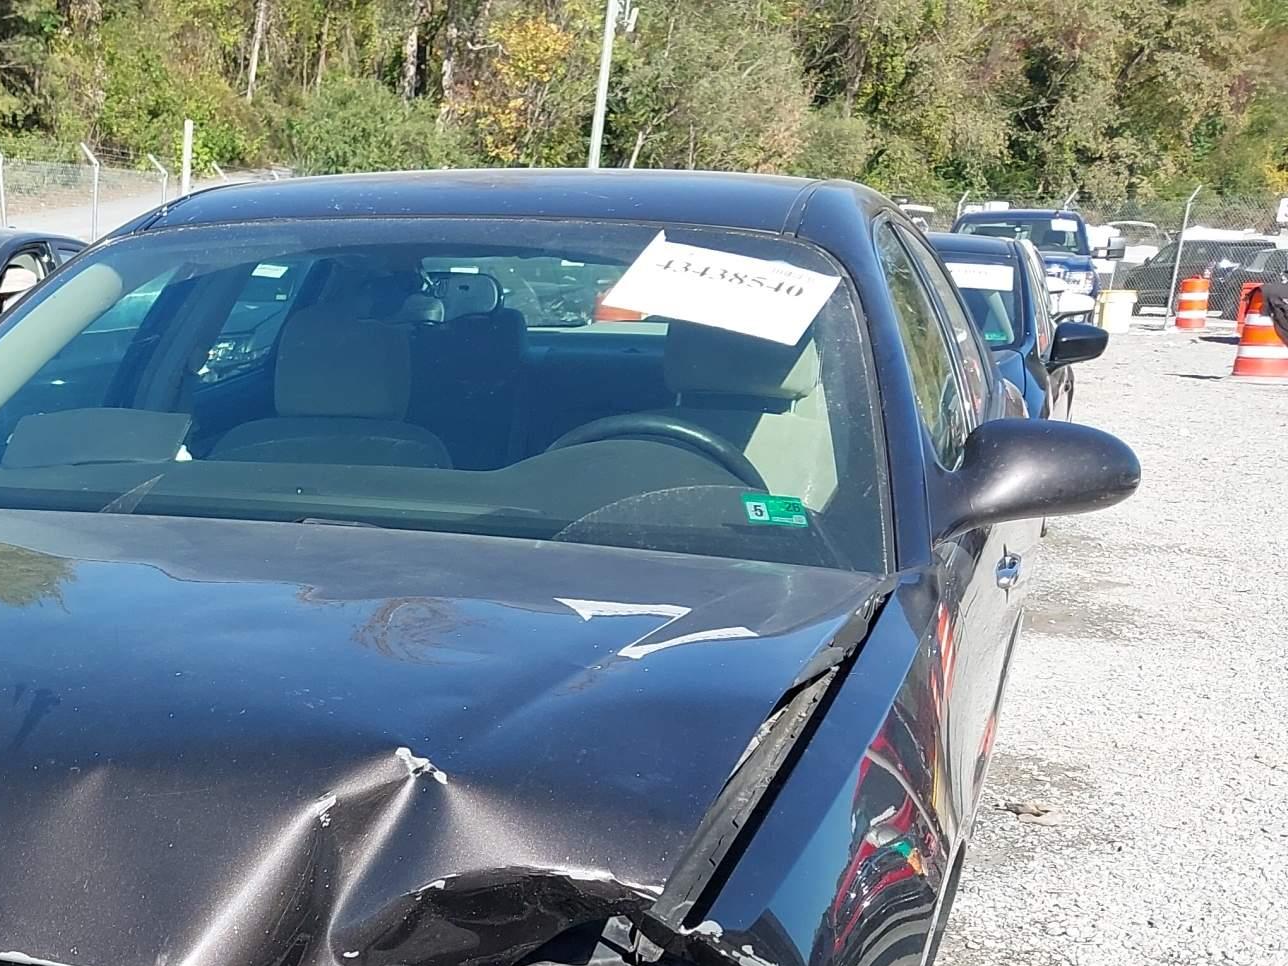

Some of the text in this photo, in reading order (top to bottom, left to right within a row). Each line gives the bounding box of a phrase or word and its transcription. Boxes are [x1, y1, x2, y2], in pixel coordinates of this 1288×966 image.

[655, 258, 805, 298] 43438540
[753, 501, 801, 517] 5 26
